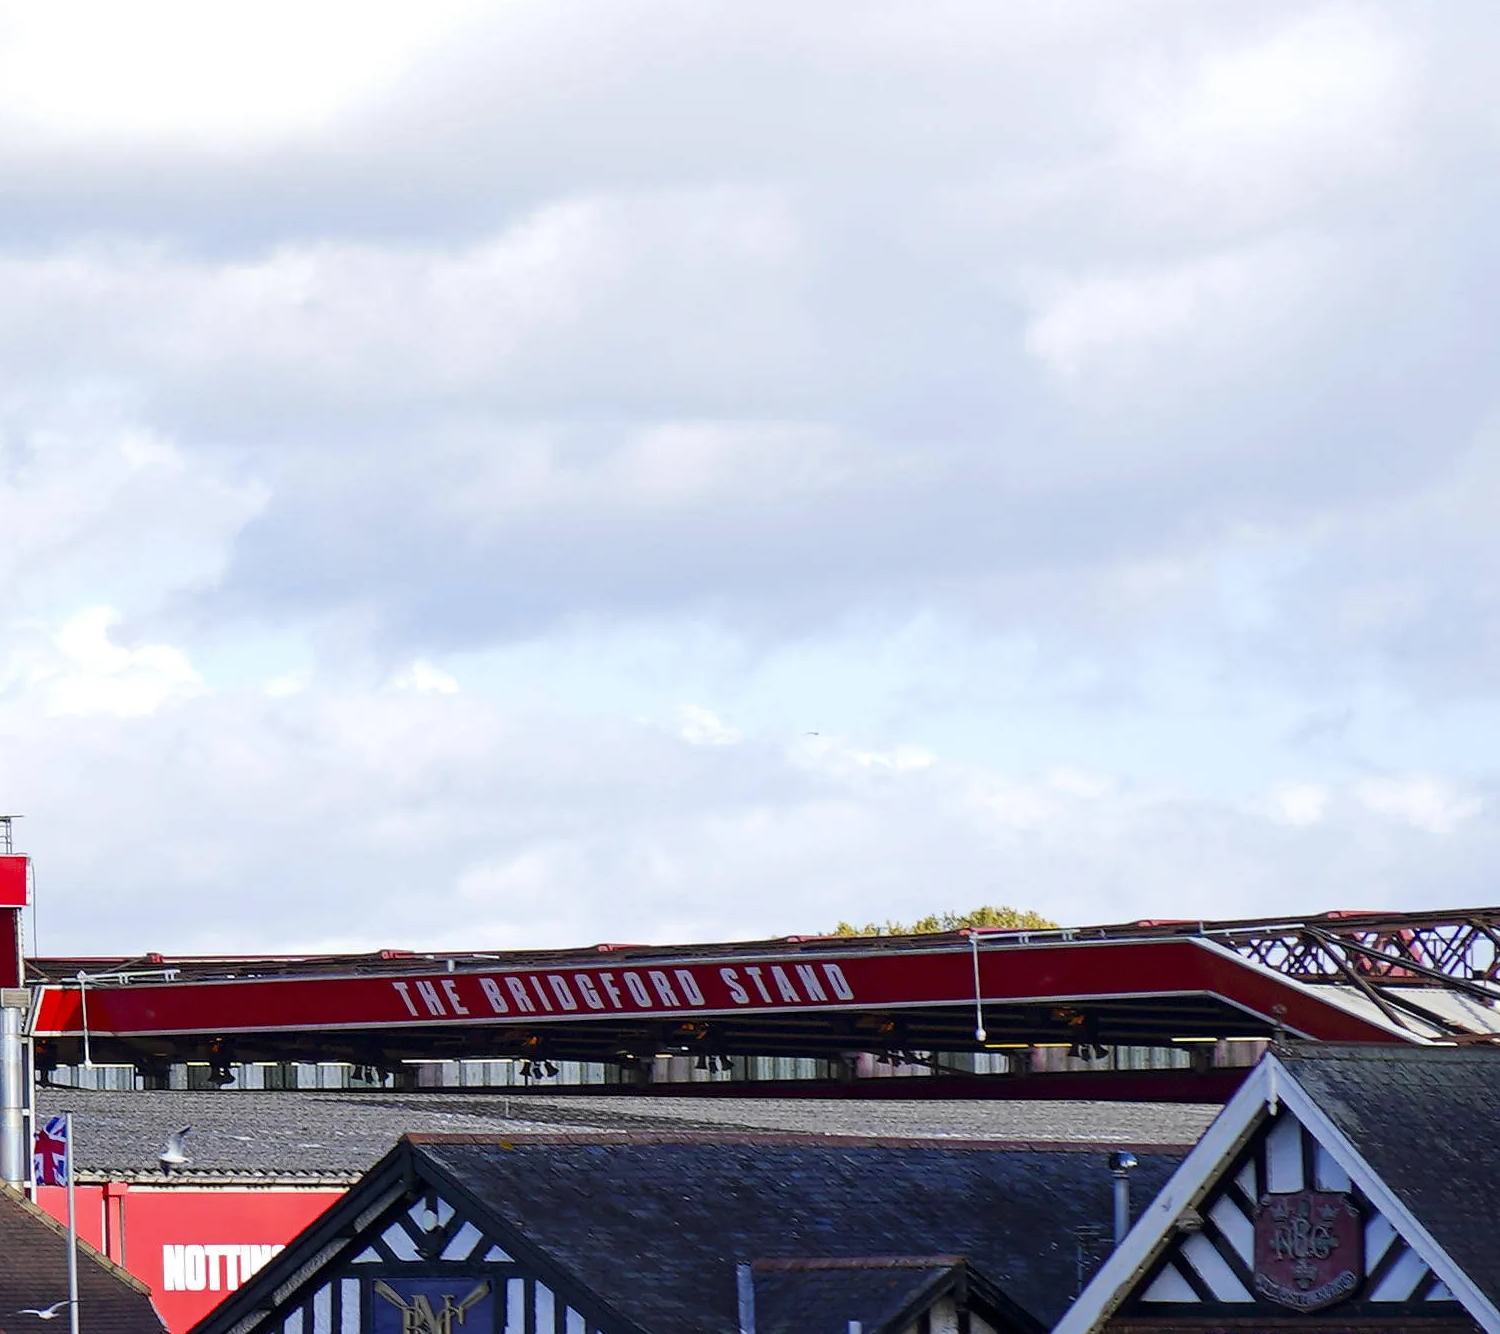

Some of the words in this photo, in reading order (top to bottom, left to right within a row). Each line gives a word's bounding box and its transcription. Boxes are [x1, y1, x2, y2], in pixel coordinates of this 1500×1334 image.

[392, 979, 471, 1017] THE
[479, 968, 706, 1013] BRIDGFORD
[719, 962, 855, 1004] STAND
[162, 1244, 286, 1291] NOTTIN
